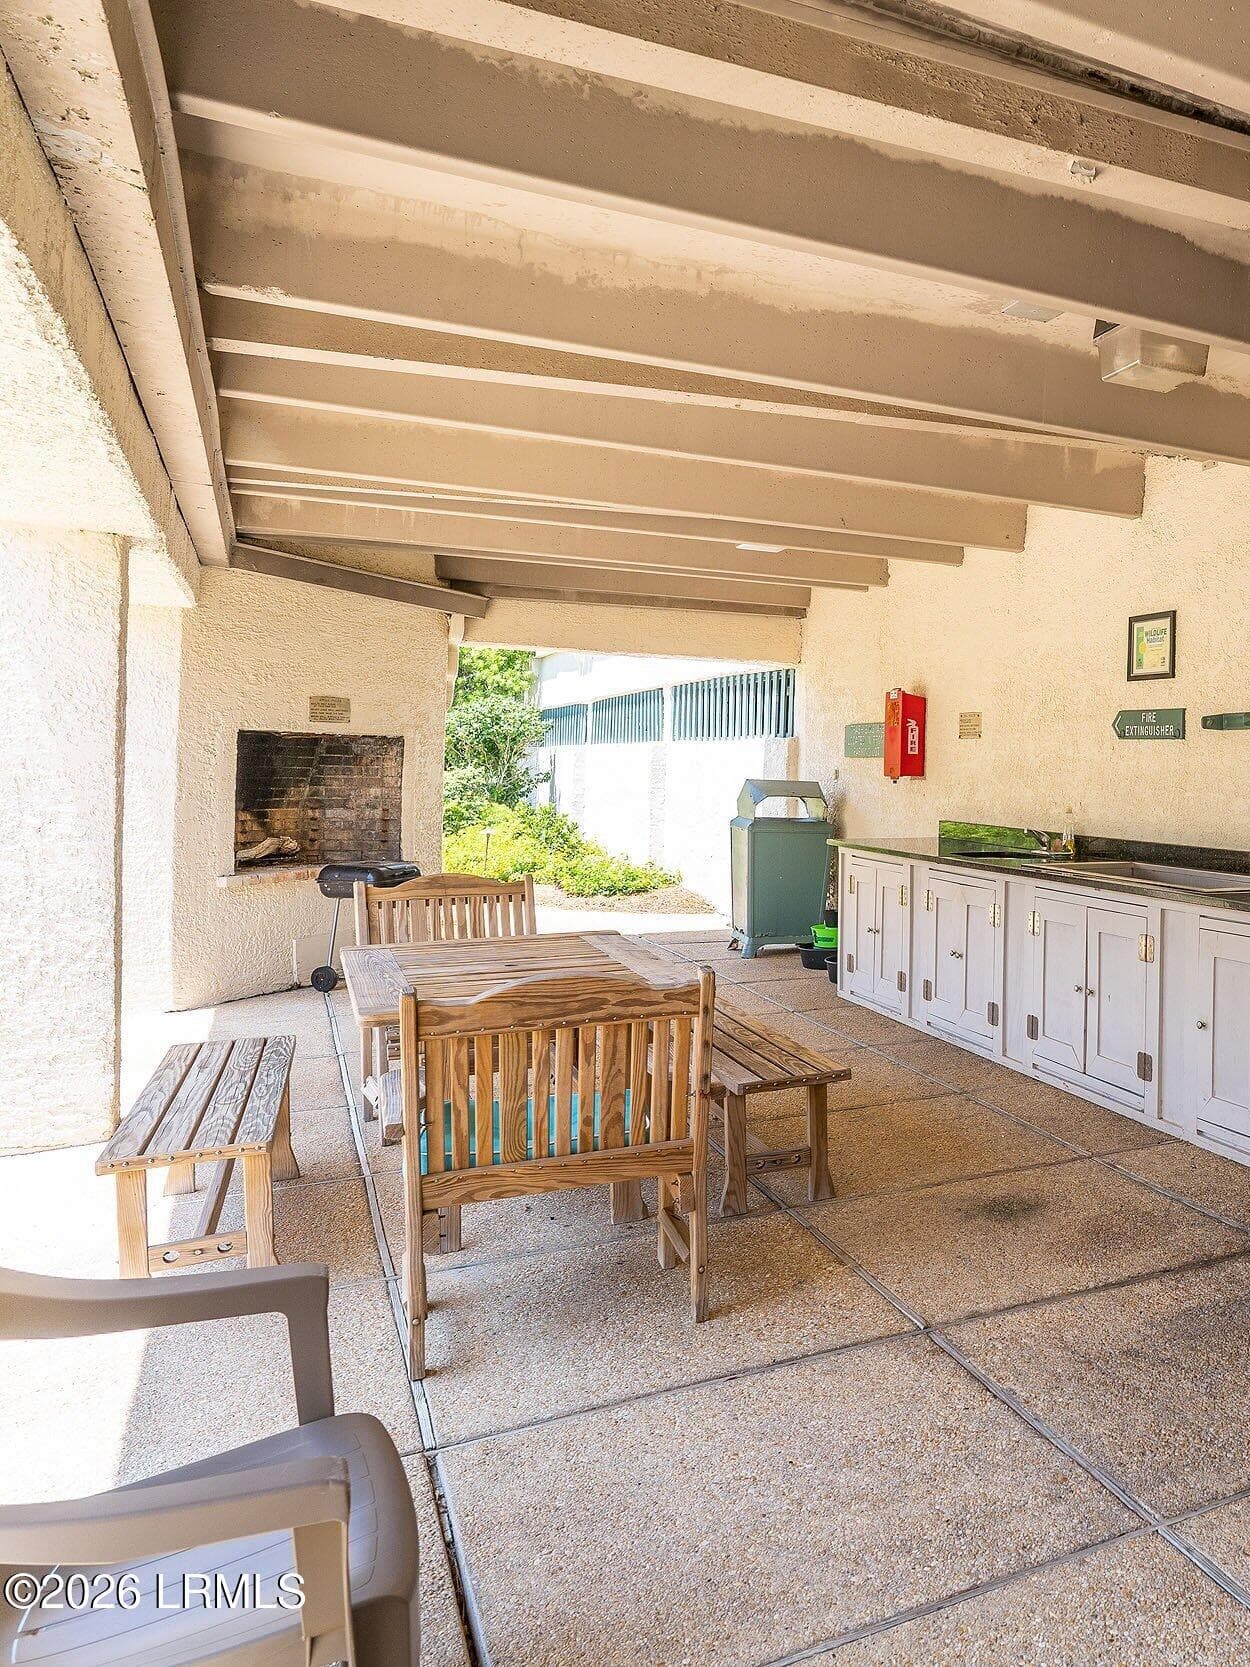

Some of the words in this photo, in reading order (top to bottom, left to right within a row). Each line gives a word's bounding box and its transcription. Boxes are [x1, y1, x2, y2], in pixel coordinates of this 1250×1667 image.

[1141, 712, 1156, 722] FIRE
[1125, 725, 1174, 736] EXTINGUISHER
[909, 727, 917, 753] FIRE
